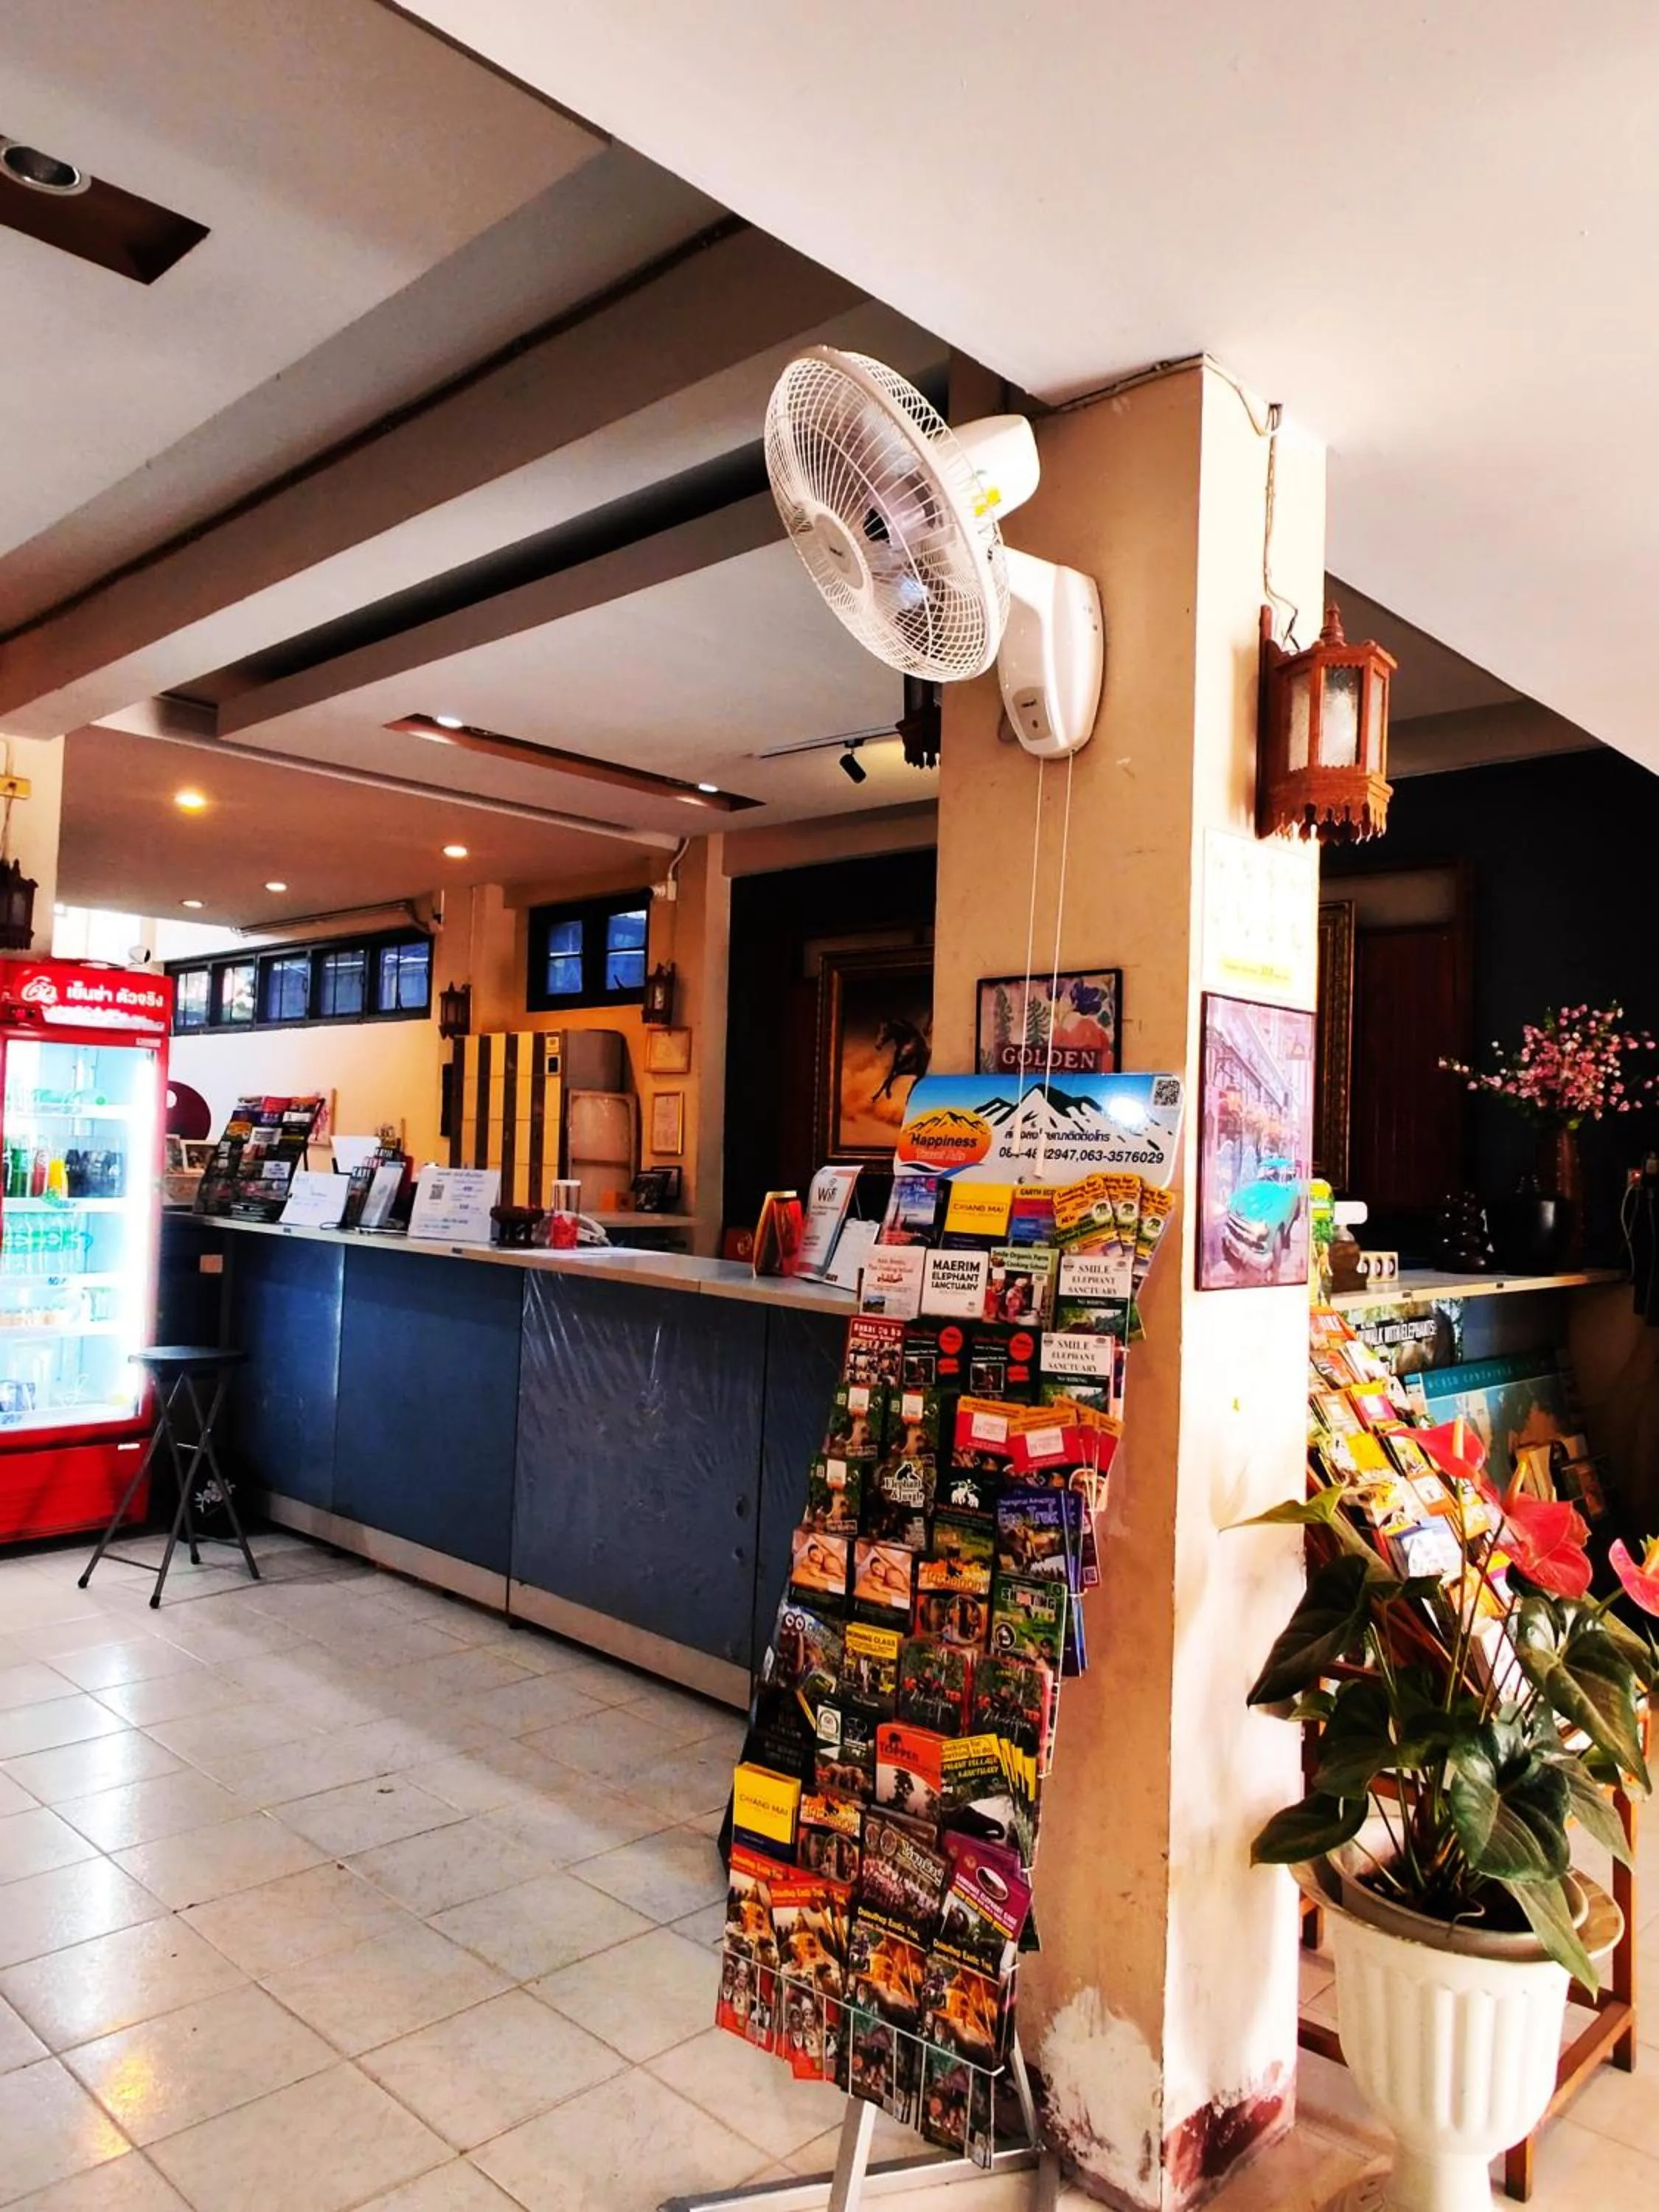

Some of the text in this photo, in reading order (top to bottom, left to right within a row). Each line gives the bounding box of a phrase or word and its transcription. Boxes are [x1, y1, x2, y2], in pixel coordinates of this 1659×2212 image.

[1002, 1047, 1096, 1068] GOLDEN
[911, 1133, 978, 1150] Happiness
[933, 1259, 981, 1273] MAERIM
[1078, 1265, 1111, 1274] SMILE
[931, 1272, 980, 1282] ELEPHANT
[1072, 1275, 1116, 1285] ELEPHANT
[1057, 1340, 1089, 1350] SMILE
